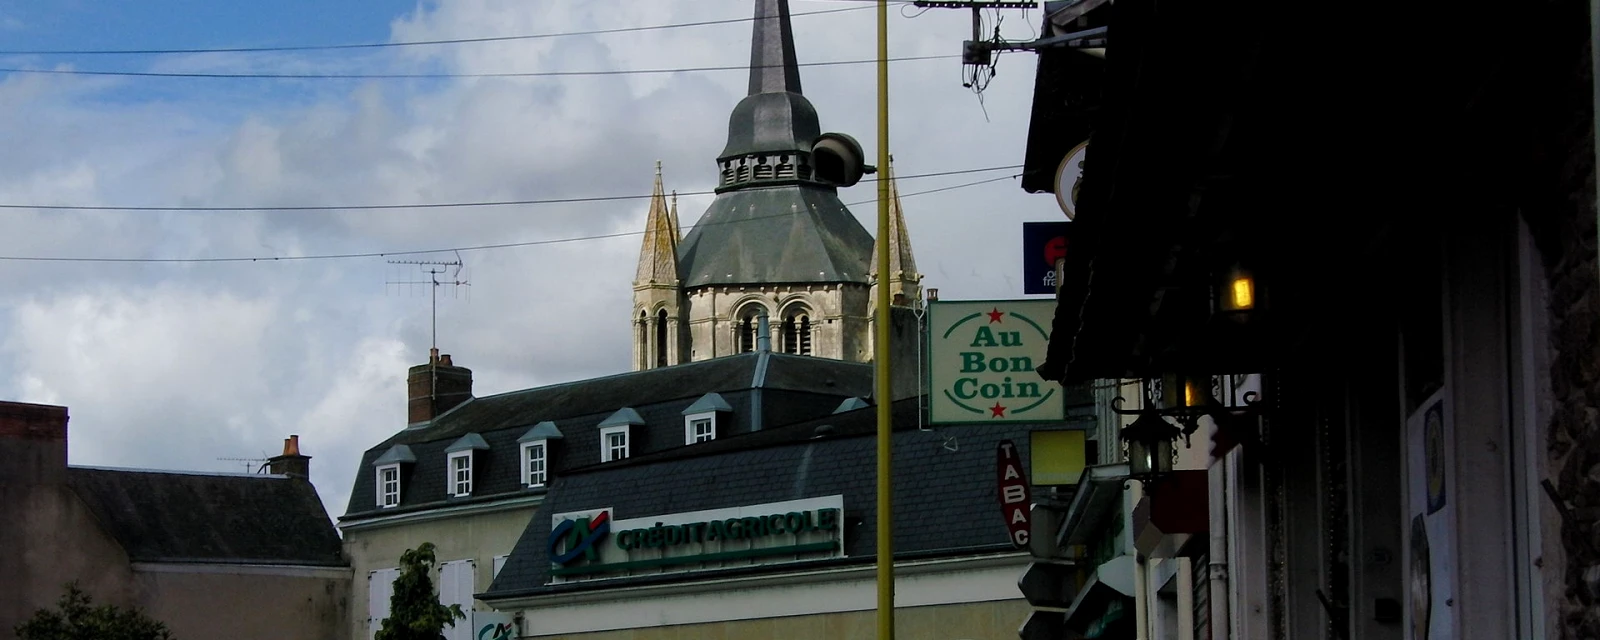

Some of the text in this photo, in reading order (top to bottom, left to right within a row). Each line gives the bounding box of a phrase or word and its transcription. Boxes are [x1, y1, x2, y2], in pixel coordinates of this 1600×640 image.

[970, 326, 1023, 347] Au
[960, 352, 1034, 373] Bon
[954, 377, 1041, 399] Coin
[1000, 443, 1029, 546] TABAC
[617, 508, 838, 550] CRÉDIT AGRICOLE
